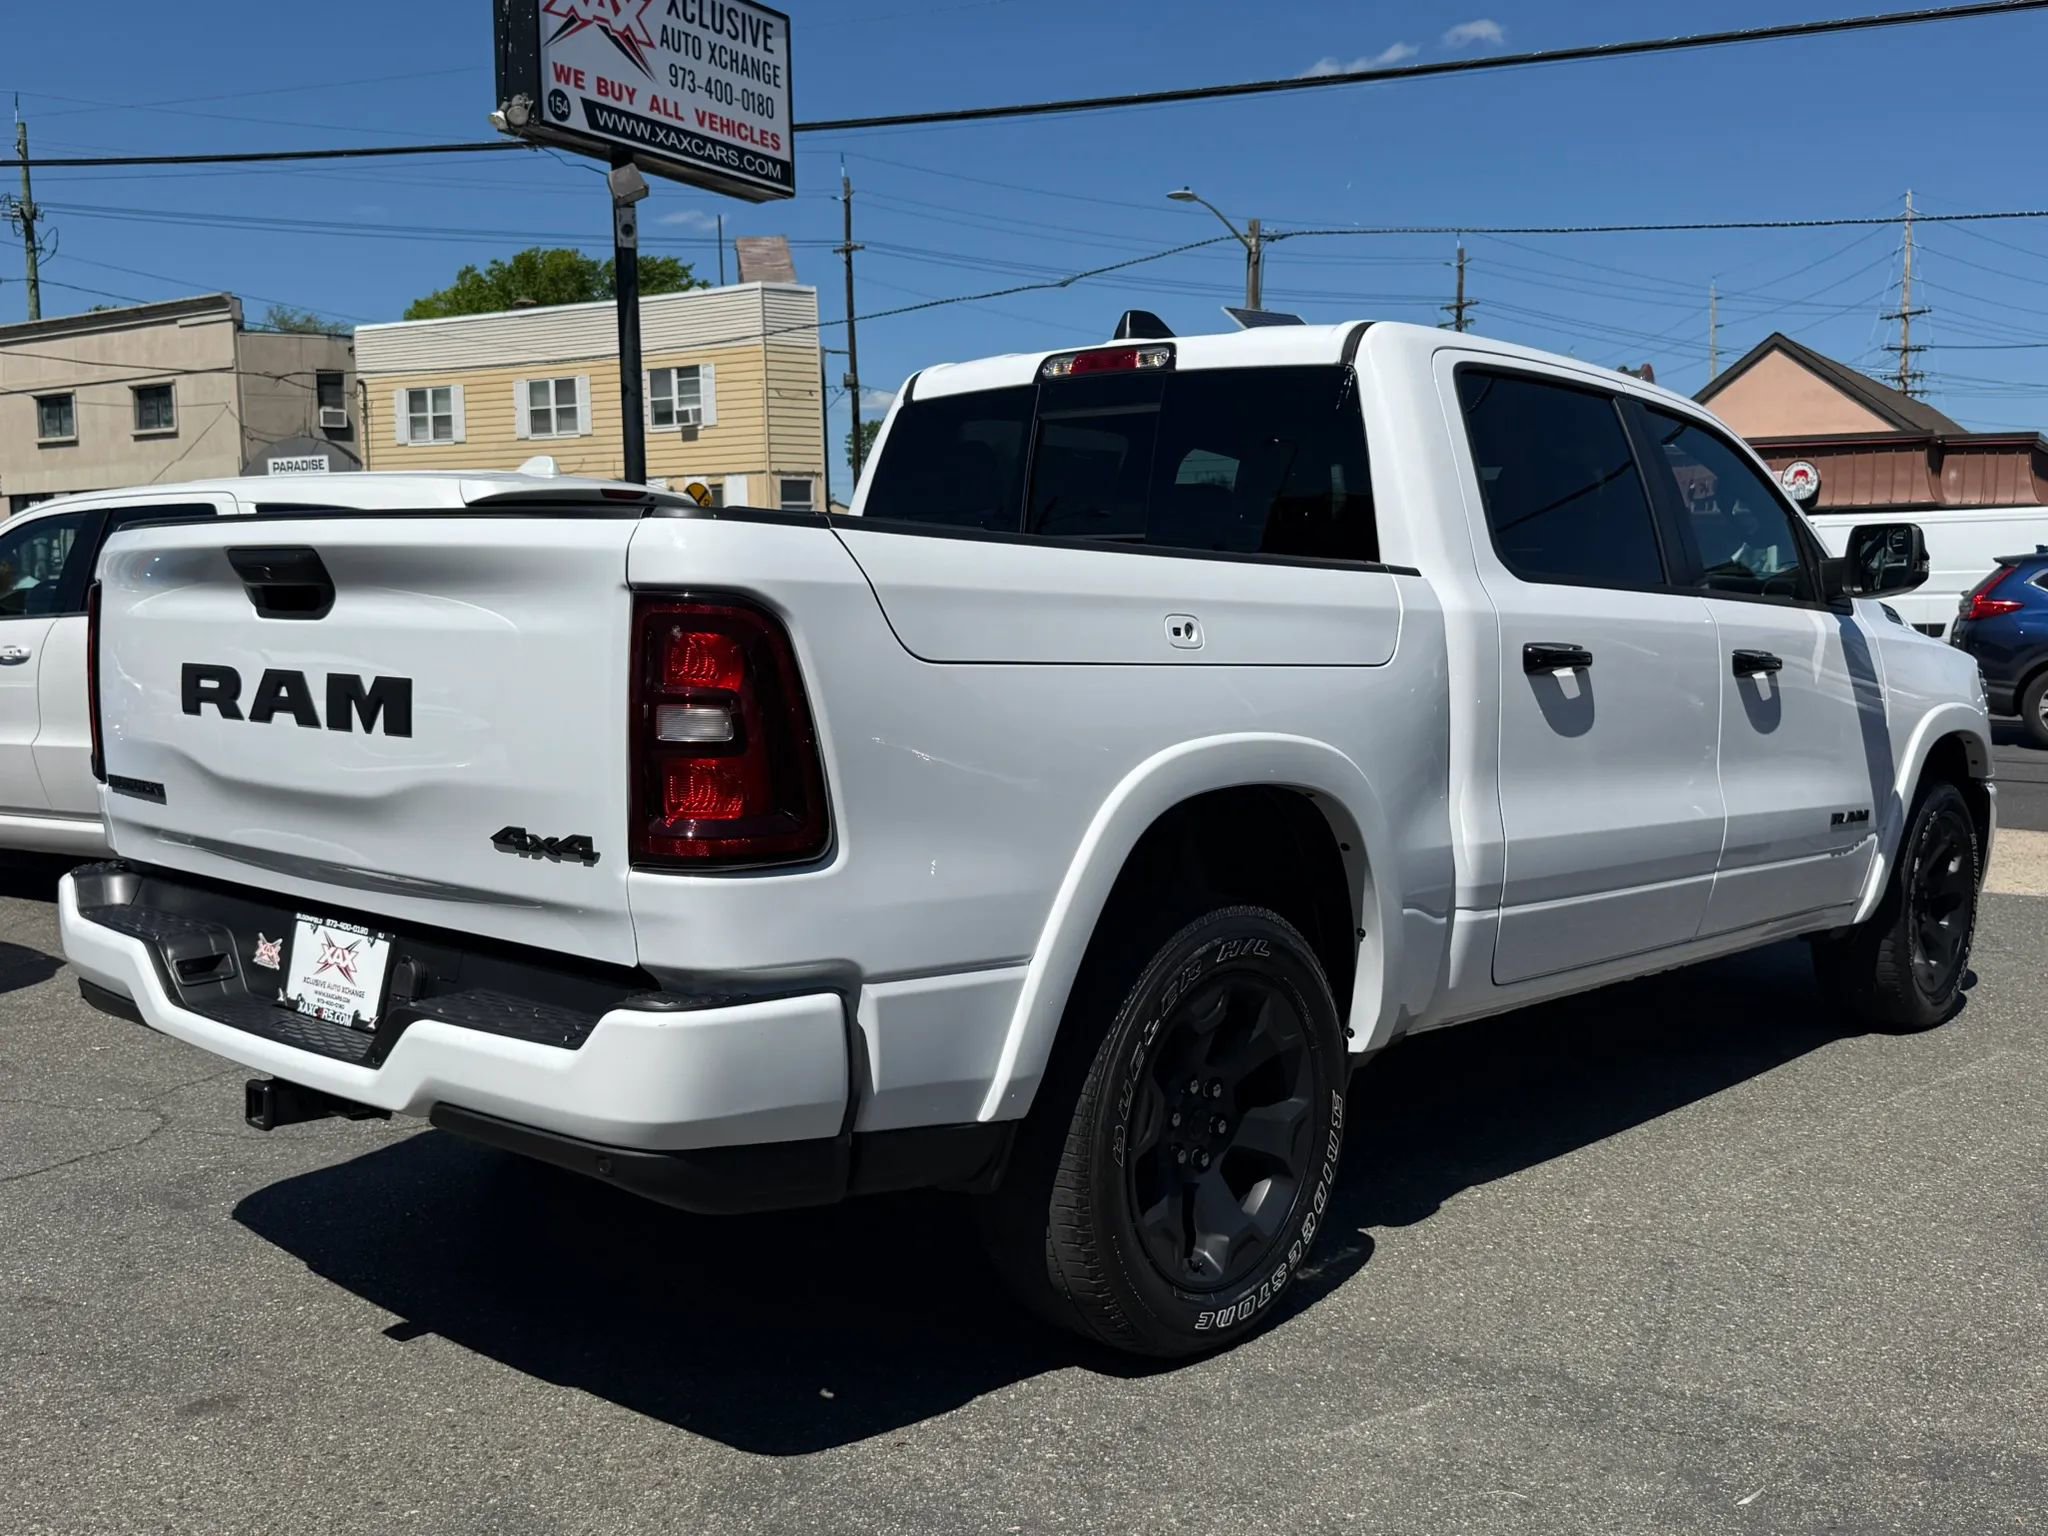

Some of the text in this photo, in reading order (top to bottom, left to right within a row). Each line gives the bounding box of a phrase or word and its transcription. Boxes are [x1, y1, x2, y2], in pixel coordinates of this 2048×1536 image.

[660, 24, 781, 88] AUTO XCHANGE
[549, 95, 569, 115] 154
[553, 61, 781, 151] WE BUY ALL VEHICLES
[669, 63, 774, 119] 973-400-0180
[596, 108, 781, 179] WWW.XAXCARS.COM
[273, 459, 325, 472] PARADISE
[182, 663, 412, 738] RAM
[1831, 809, 1870, 826] RAM
[1195, 1089, 1343, 1330] BRIDGESTONE
